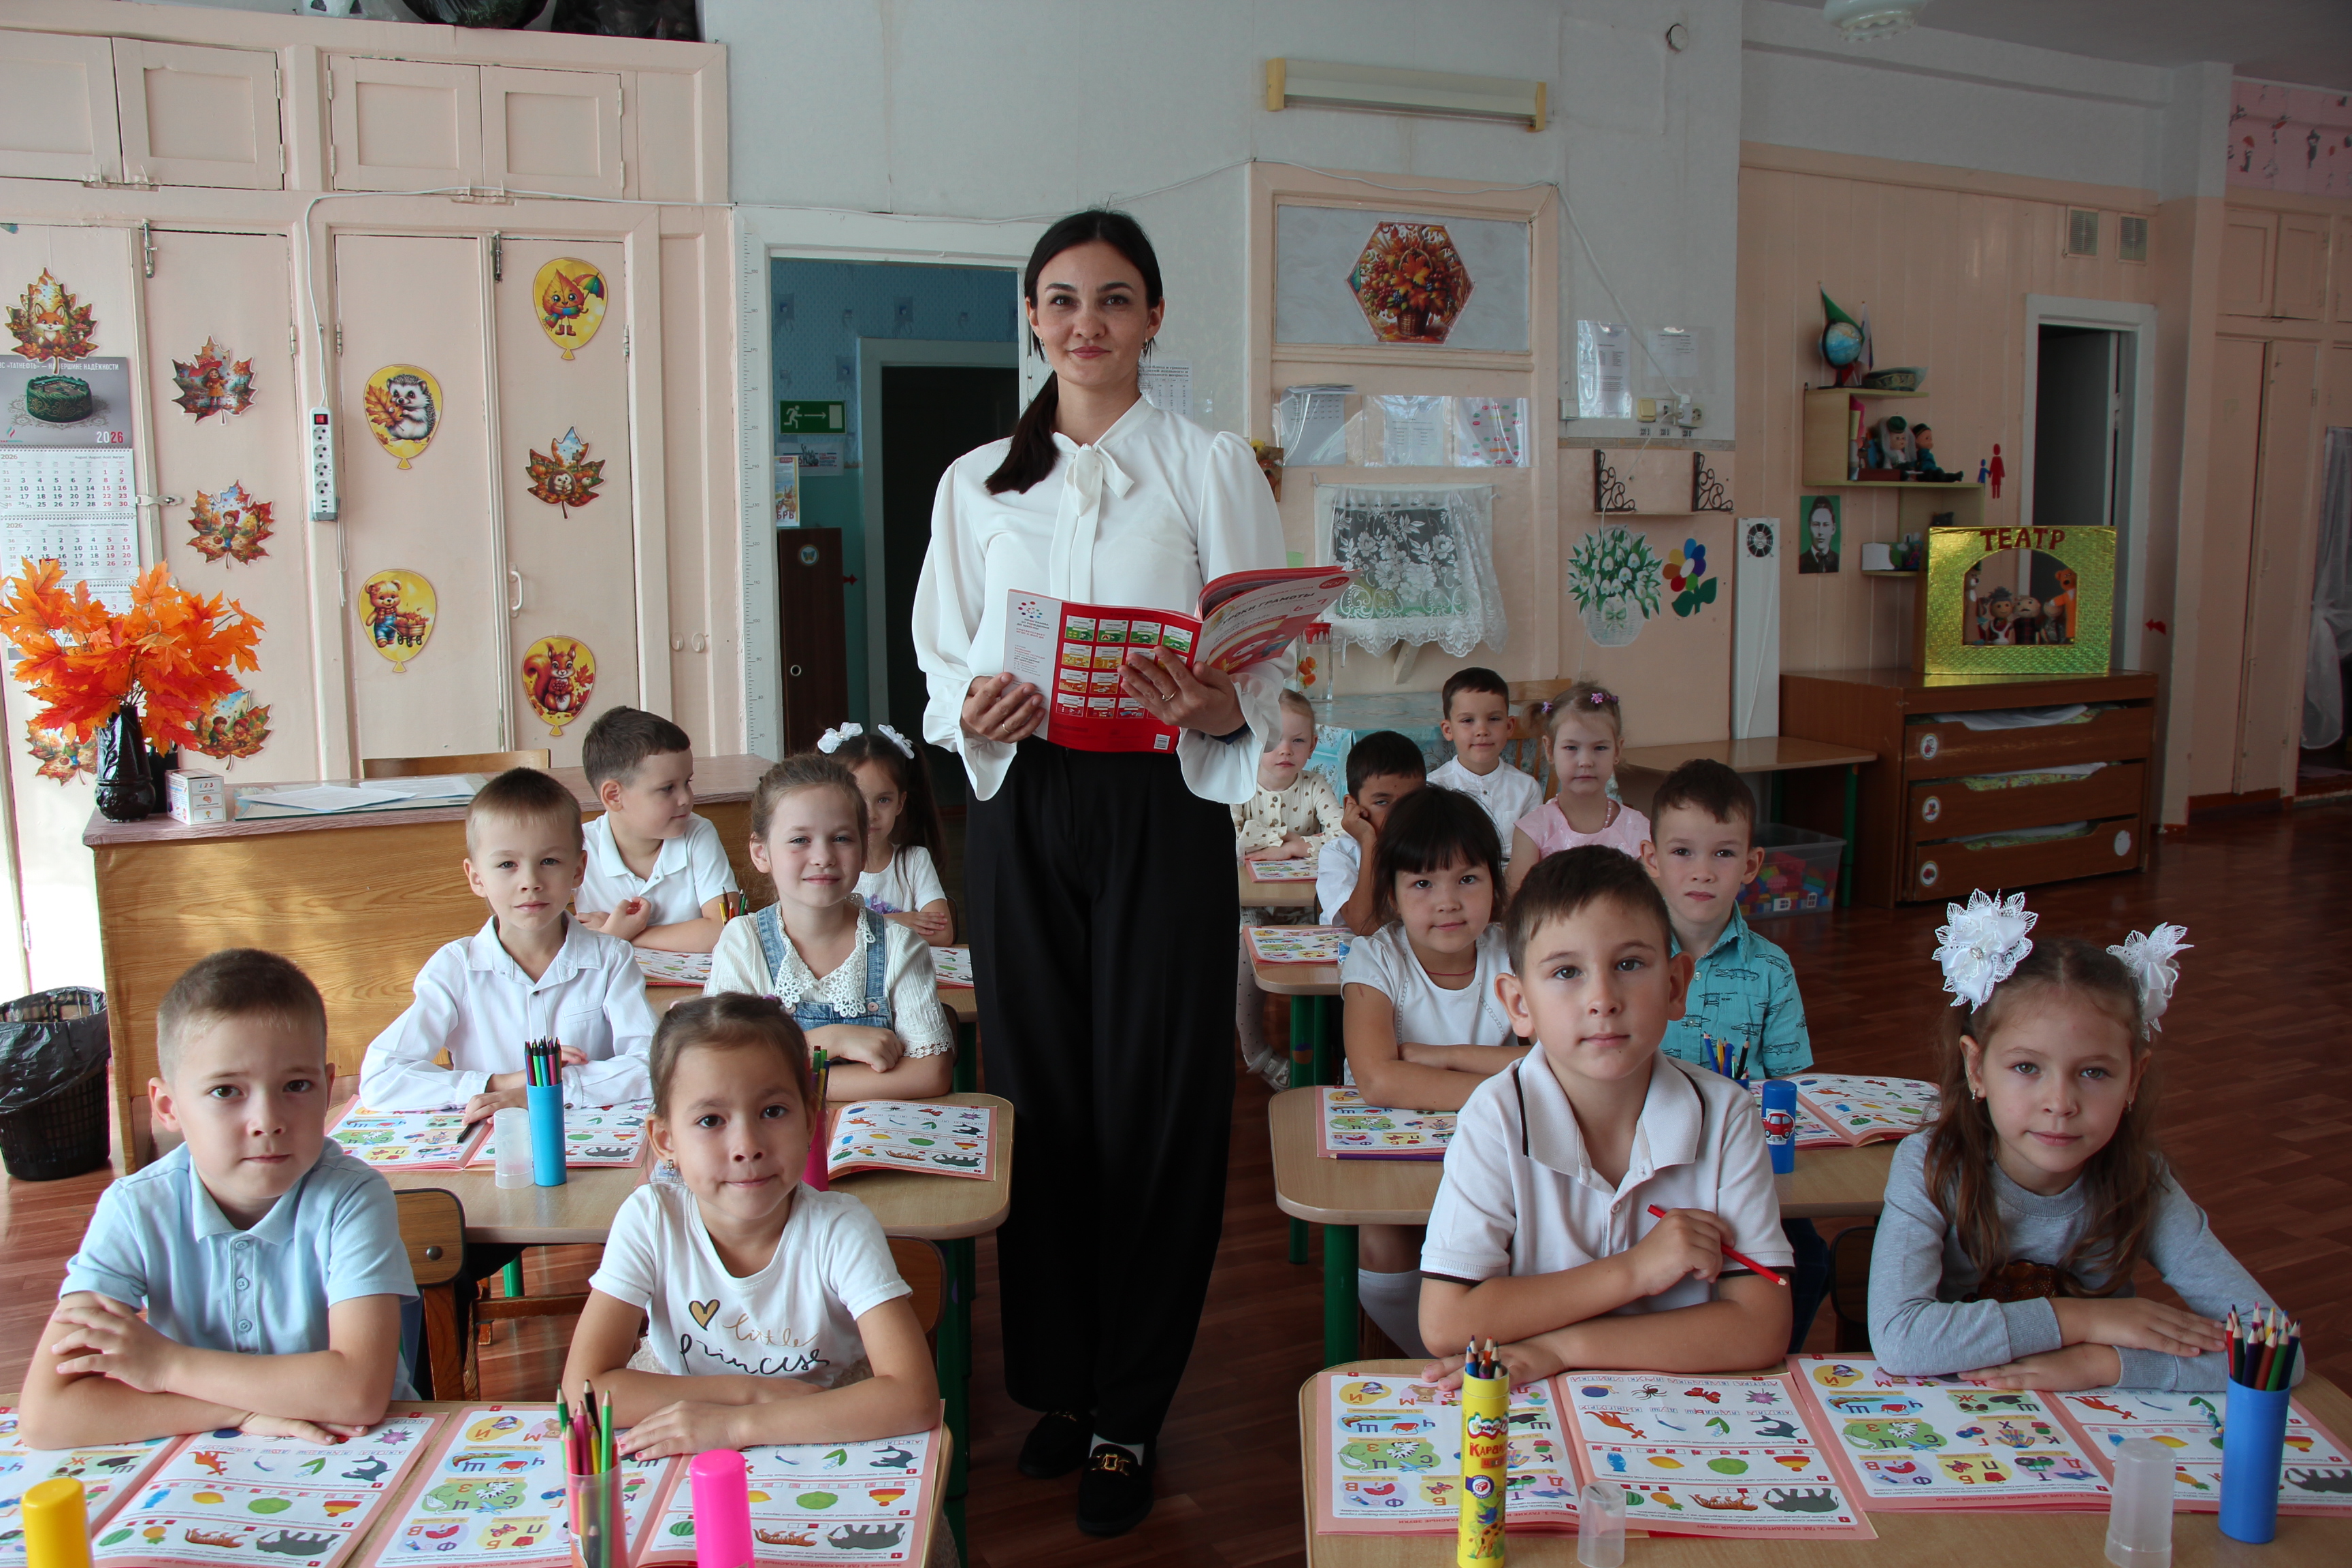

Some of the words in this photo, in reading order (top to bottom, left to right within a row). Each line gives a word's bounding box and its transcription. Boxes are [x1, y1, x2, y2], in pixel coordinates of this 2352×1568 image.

[83, 363, 119, 371] НАДЁЖНОСТИ
[97, 431, 124, 444] 2026
[1980, 527, 2065, 551] ТЕАТР
[1222, 605, 1257, 626] УРОКИ
[1258, 592, 1316, 608] ГРАМОТЫ
[722, 1313, 819, 1348] little
[1443, 1390, 1455, 1399] Р
[1517, 1386, 1531, 1394] Л
[1350, 1393, 1363, 1404] Й
[1399, 1398, 1415, 1406] М
[1953, 1394, 1978, 1402] Ж
[1356, 1422, 1379, 1433] Щ
[1422, 1420, 1436, 1428] Ч
[1530, 1421, 1551, 1430] Ш
[1997, 1420, 2014, 1429] Х
[2044, 1435, 2061, 1445] К
[1367, 1443, 1379, 1452] З
[1420, 1454, 1433, 1464] С
[1538, 1454, 1554, 1463] К
[1372, 1458, 1388, 1469] Ц
[1863, 1460, 1880, 1471] В
[1980, 1460, 1999, 1469] П
[1547, 1475, 1564, 1487] Д
[1912, 1475, 1933, 1486] Ф
[1958, 1475, 1974, 1484] Б
[1345, 1482, 1359, 1492] В
[1511, 1491, 1524, 1501] Т
[1384, 1498, 1405, 1507] Ф
[1433, 1497, 1447, 1506] Б
